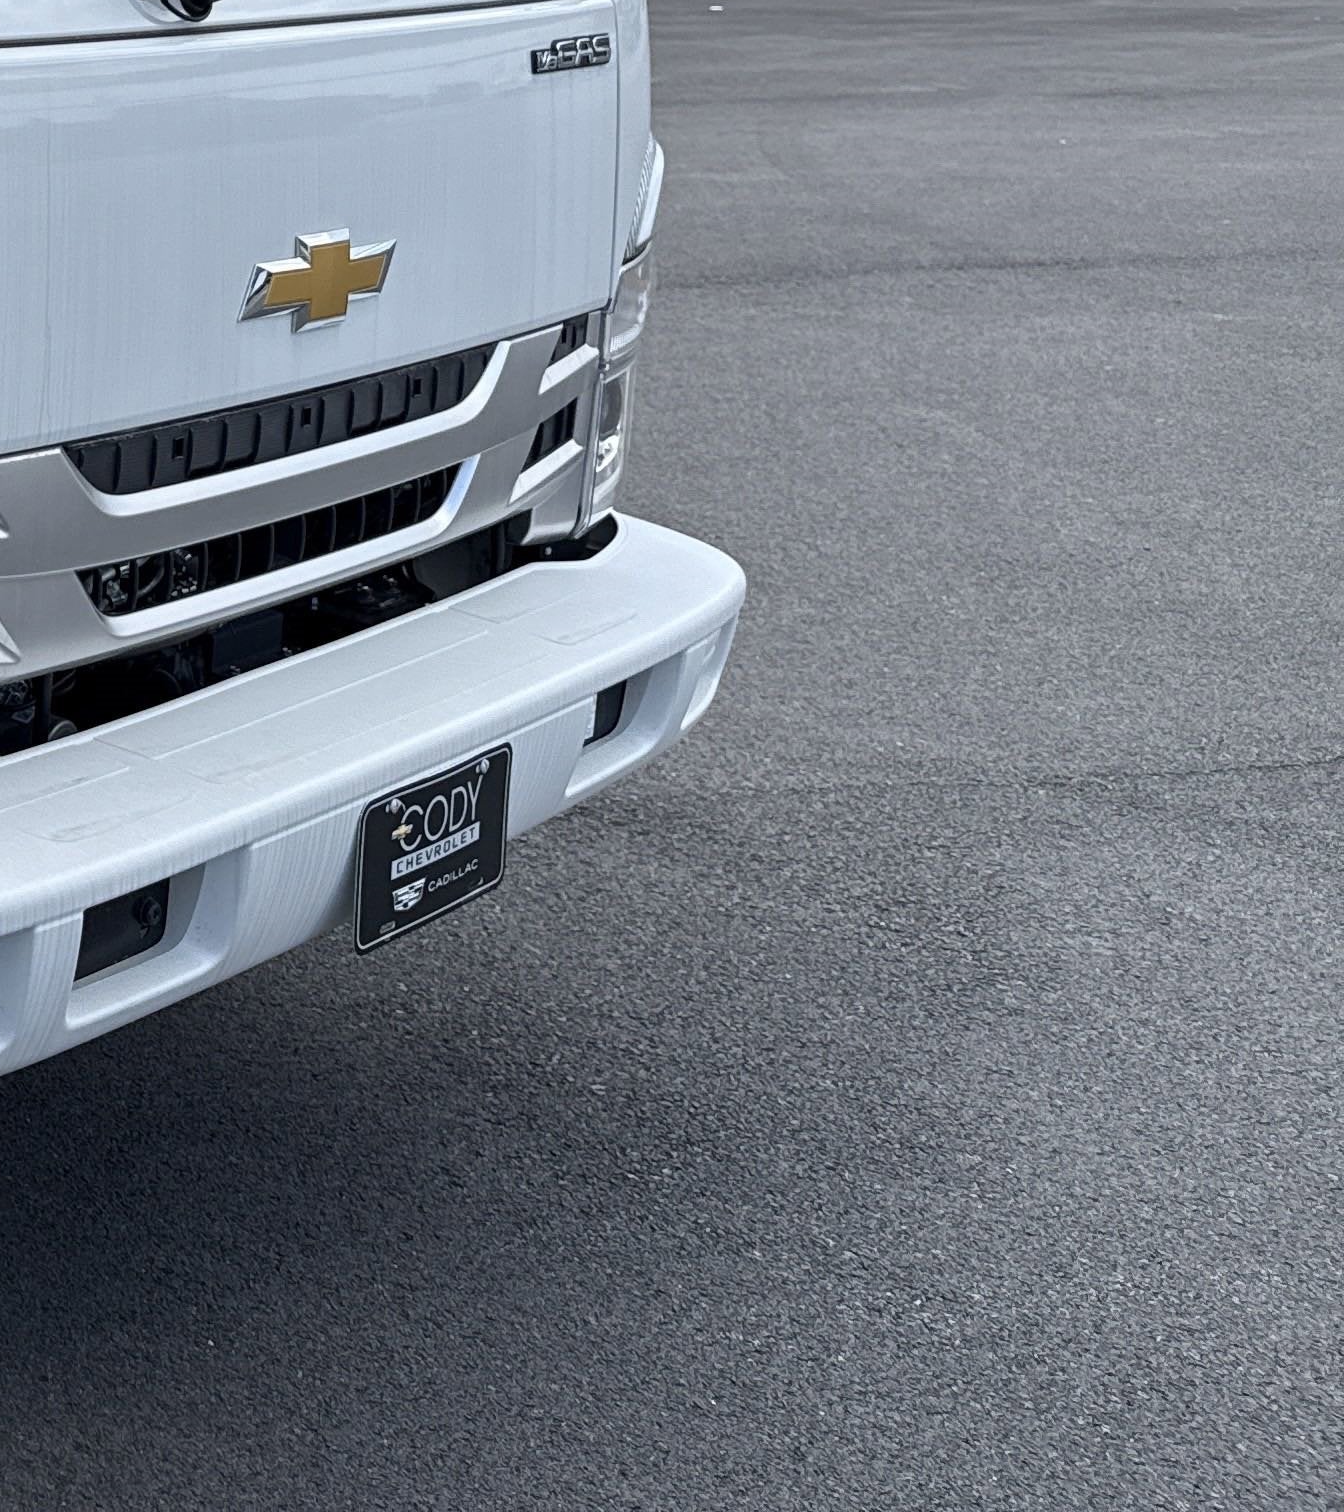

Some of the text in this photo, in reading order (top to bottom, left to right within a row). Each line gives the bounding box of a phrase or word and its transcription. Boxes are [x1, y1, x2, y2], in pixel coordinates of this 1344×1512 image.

[557, 37, 610, 67] GAS
[399, 774, 483, 852] CODY
[395, 828, 477, 874] CHEVROLET
[428, 859, 479, 892] CADILLAC
